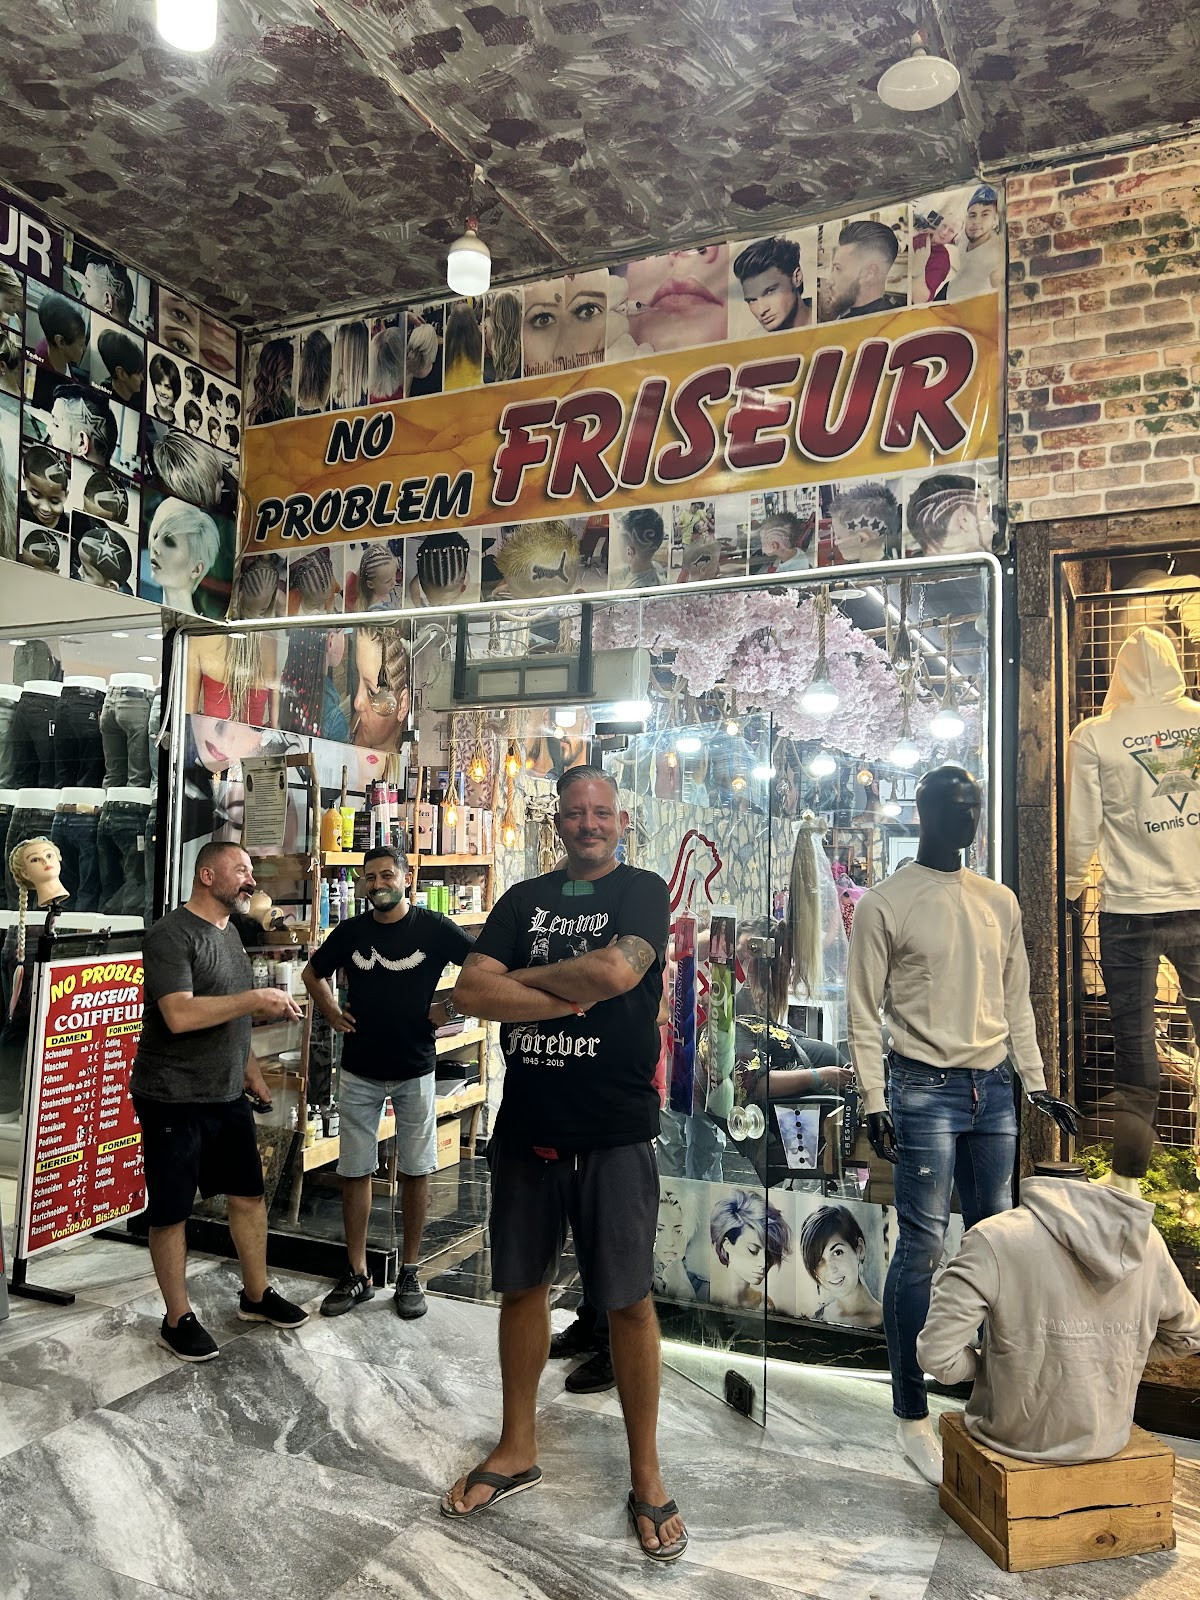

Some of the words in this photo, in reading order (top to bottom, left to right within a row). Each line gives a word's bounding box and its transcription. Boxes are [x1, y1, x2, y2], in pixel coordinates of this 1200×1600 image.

[492, 326, 978, 507] FRISEUR
[325, 411, 396, 465] NO
[254, 469, 475, 542] PROBLEM
[1144, 816, 1184, 834] Tennis
[51, 974, 77, 1003] NO
[81, 963, 144, 988] PROBLE
[71, 986, 139, 1010] FRISEUR
[109, 1027, 122, 1035] FOR
[124, 1022, 143, 1032] WOME
[51, 1032, 88, 1045] DAMEN
[45, 1048, 73, 1060] Schneiden
[81, 1045, 89, 1053] ab
[90, 1043, 94, 1051] 7
[95, 1041, 100, 1050] €
[44, 1061, 69, 1072] Waschen
[88, 1055, 93, 1063] 2
[94, 1053, 99, 1061] €
[79, 1069, 86, 1077] ab
[93, 1065, 98, 1073] €
[548, 1059, 565, 1067] 2015
[76, 1081, 83, 1090] ab
[84, 1079, 91, 1088] 25
[92, 1077, 97, 1086] €
[75, 1093, 82, 1102] ab
[92, 1088, 97, 1097] €
[41, 1112, 60, 1122] Farben
[73, 1105, 80, 1114] ab
[91, 1101, 96, 1109] €
[90, 1112, 95, 1120] €
[89, 1124, 94, 1133] €
[93, 1135, 98, 1144] €
[102, 1136, 138, 1152] FORMEN
[40, 1153, 80, 1171] HERREN
[36, 1172, 60, 1185] Waschen
[78, 1164, 83, 1172] 2
[84, 1161, 89, 1170] €
[33, 1199, 53, 1210] Farben
[73, 1189, 81, 1197] 15
[82, 1185, 87, 1194] €
[34, 1183, 63, 1198] Schneiden
[68, 1179, 76, 1187] ab
[75, 1200, 80, 1208] 5
[81, 1197, 86, 1206] €
[31, 1222, 56, 1236] Rasieren
[80, 1209, 85, 1217] €
[51, 1217, 92, 1240] Von:09.00
[95, 1203, 131, 1224] Bis:24.00
[1039, 1317, 1096, 1335] CANADA
